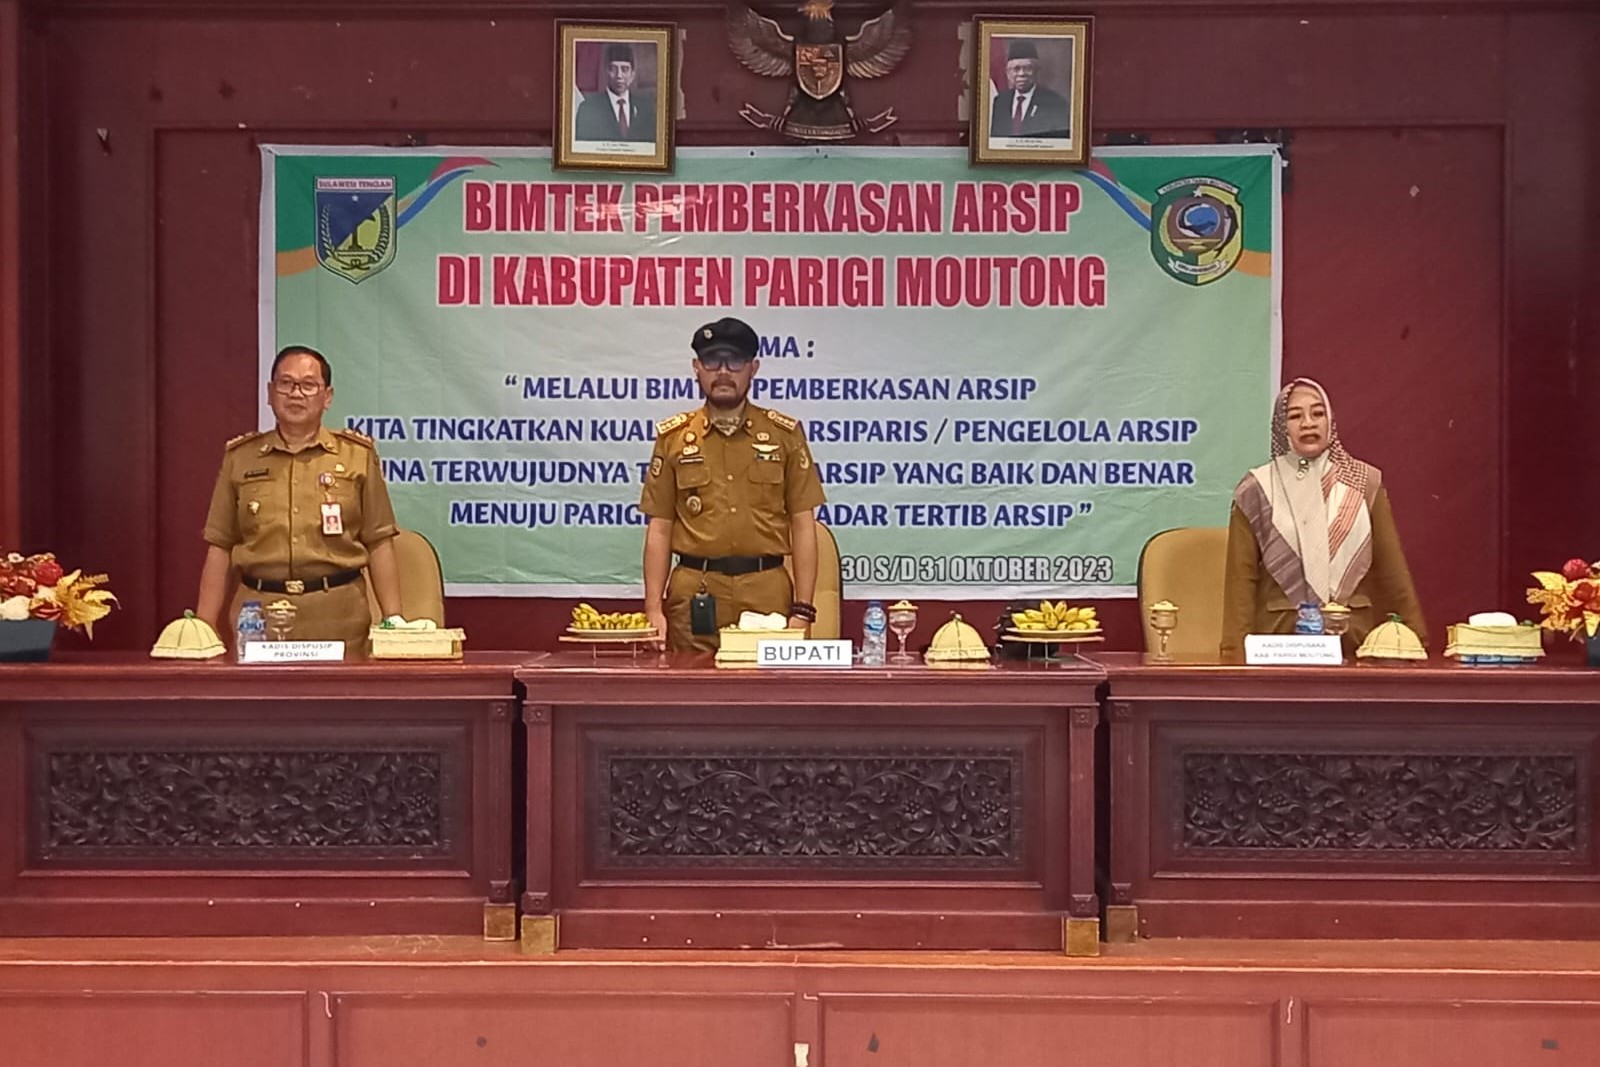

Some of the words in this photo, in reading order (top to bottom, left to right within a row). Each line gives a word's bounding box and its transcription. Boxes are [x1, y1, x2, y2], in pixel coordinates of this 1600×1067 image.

[466, 183, 622, 232] BIMTEK
[635, 184, 941, 232] PEMBERKASAN
[953, 184, 1079, 232] ARSIP
[439, 257, 481, 304] DI
[493, 257, 733, 305] KABUPATEN
[744, 258, 884, 306] PARIGI
[897, 258, 1105, 307] MOUTONG
[758, 336, 800, 358] MA
[523, 377, 638, 400] MELALUI
[753, 378, 950, 401] PEMBERKASAN
[956, 379, 1037, 401] ARSIP
[413, 418, 583, 441] TINGKATKAN
[590, 419, 656, 441] KUAL
[954, 420, 1111, 443] PENGELOLA
[1117, 421, 1198, 443] ARSIP
[432, 461, 629, 487] TERWUJUDNYA
[892, 462, 964, 485] YANG
[971, 463, 1035, 485] BAIK
[1041, 463, 1097, 485] DAN
[1104, 463, 1194, 485] BENAR
[451, 502, 557, 528] MENUJU
[816, 504, 888, 526] ADAR
[895, 504, 987, 526] TERTIB
[993, 505, 1075, 527] ARSIP
[841, 556, 871, 581] 30
[873, 556, 916, 582] S/D
[919, 556, 947, 582] 31
[949, 556, 1050, 582] OKTOBER
[1053, 556, 1113, 582] 2023
[764, 645, 840, 661] BUPATI
